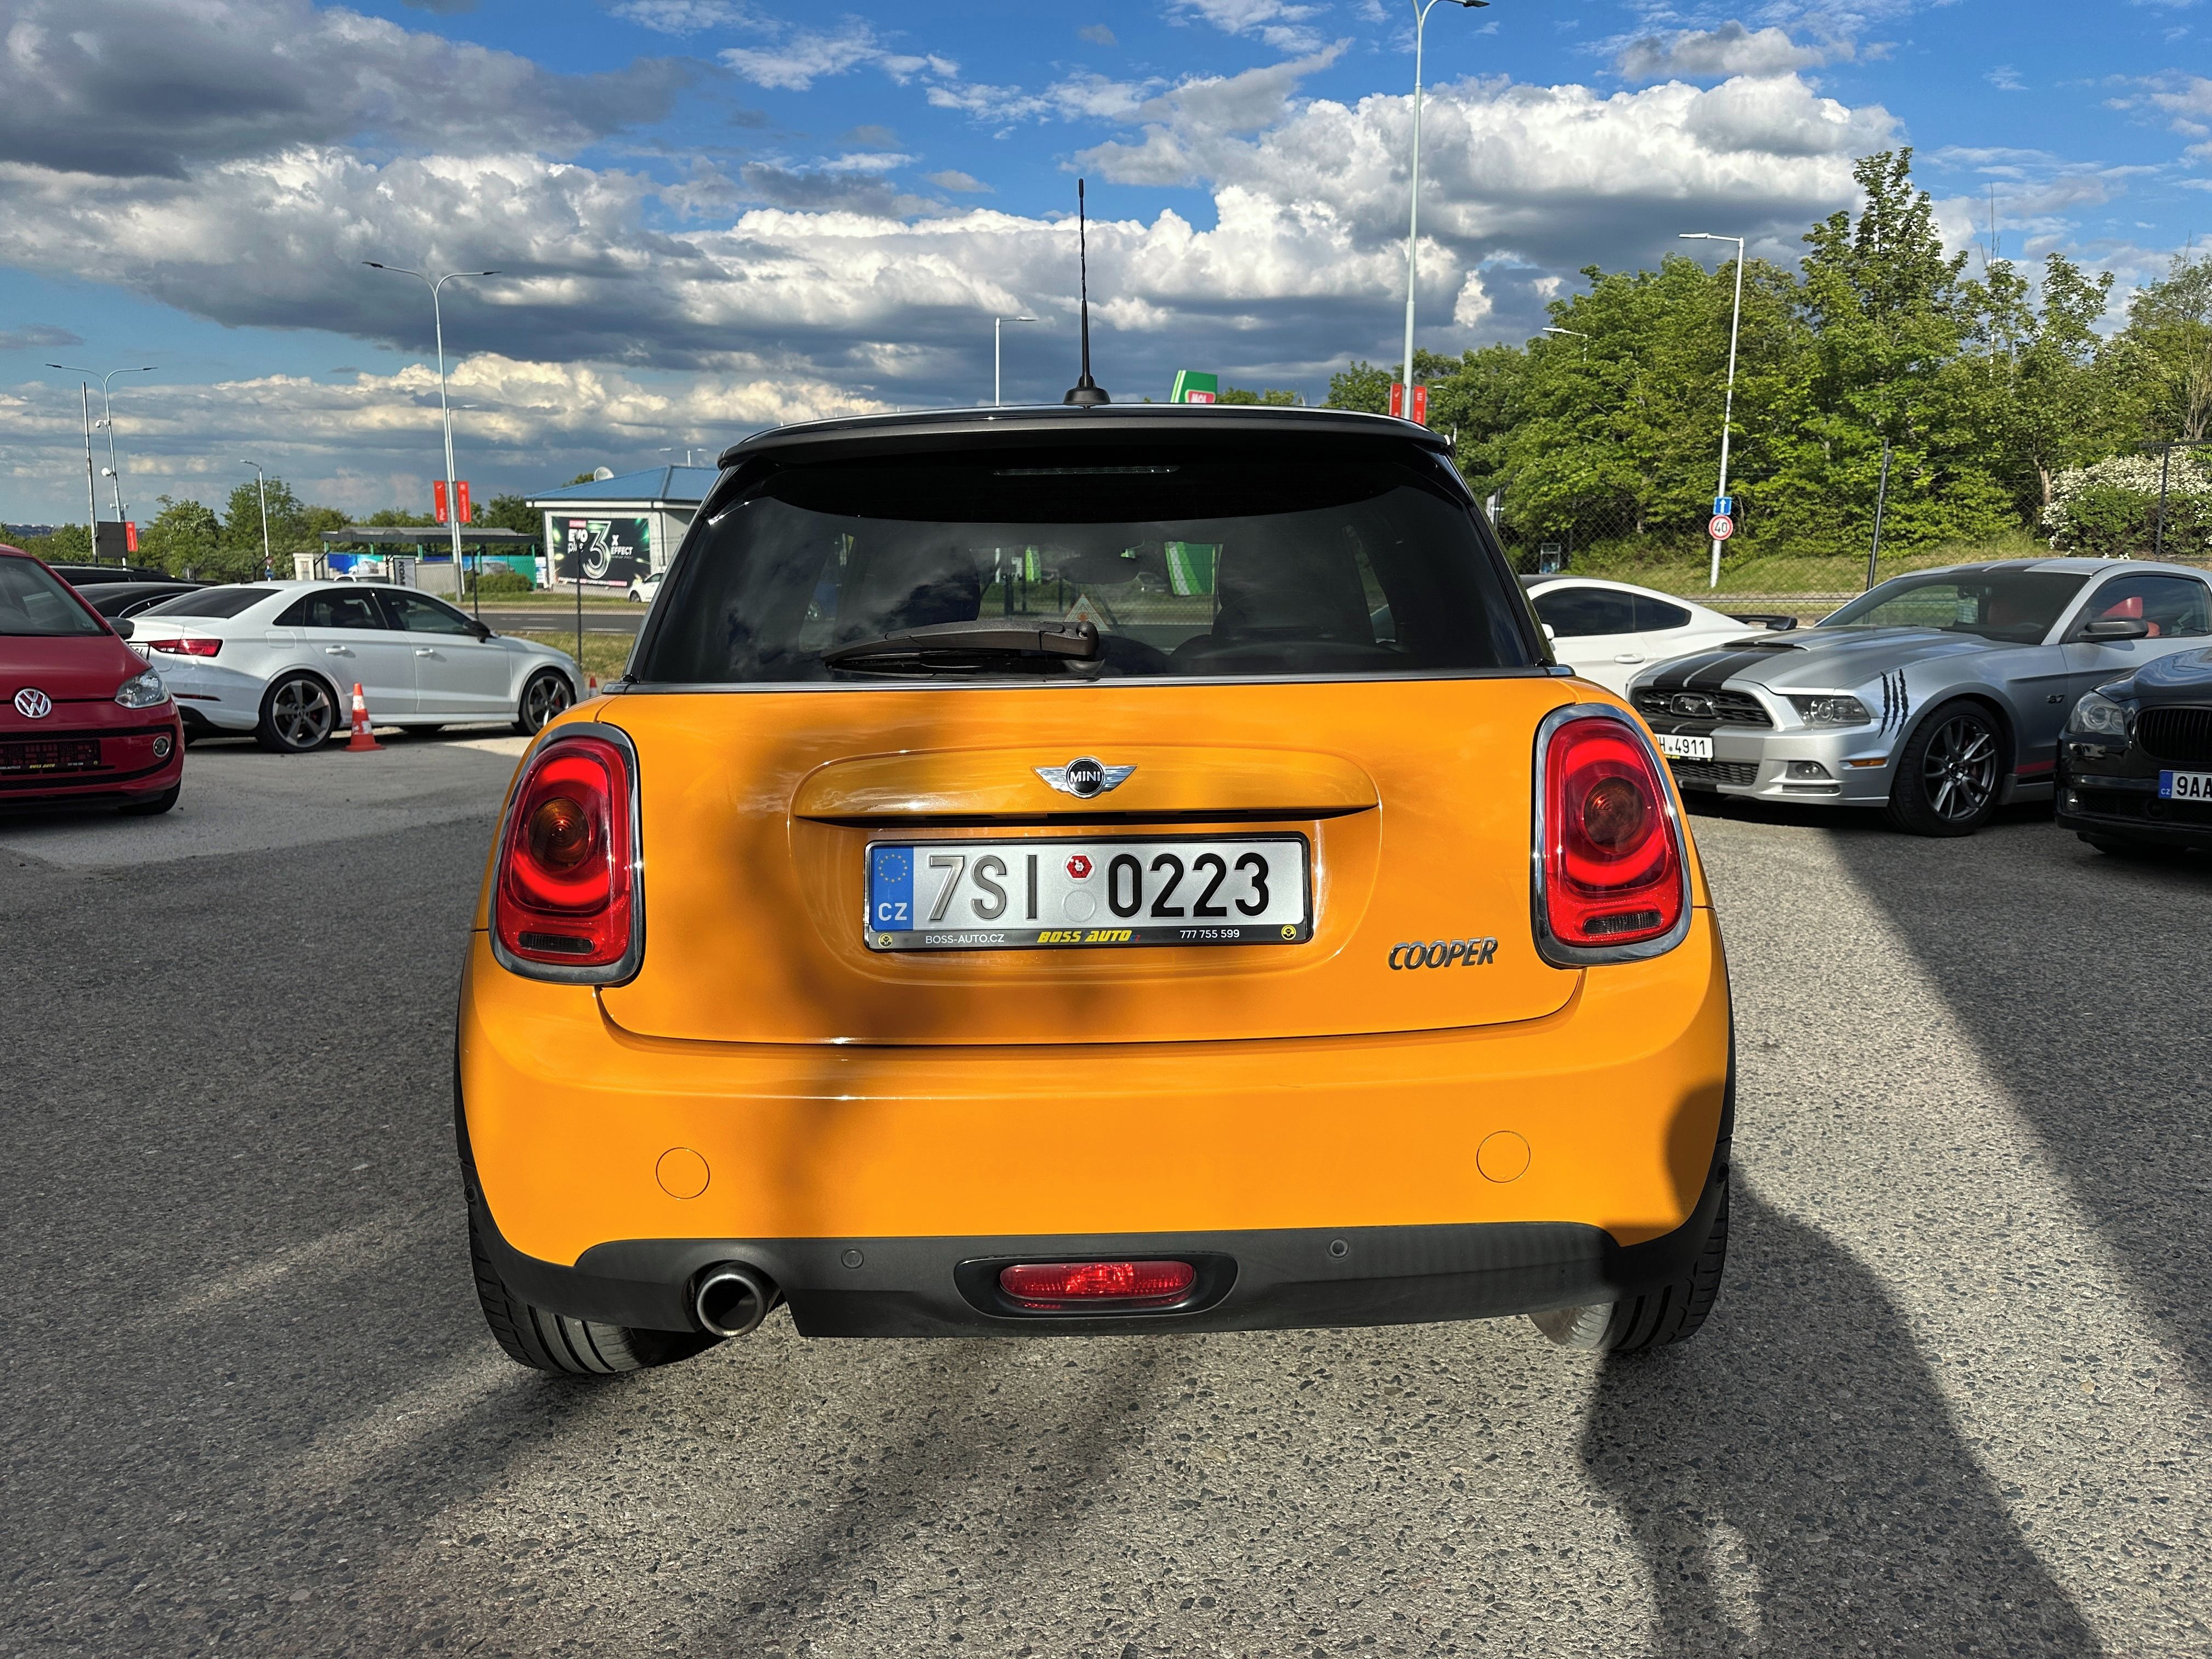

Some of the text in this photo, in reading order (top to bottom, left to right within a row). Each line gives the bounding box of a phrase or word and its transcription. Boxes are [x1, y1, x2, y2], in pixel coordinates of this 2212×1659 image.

[1715, 521, 1728, 533] 40
[568, 529, 588, 543] EVO
[582, 520, 611, 579] 3
[611, 546, 633, 555] EFFECT
[1675, 738, 1705, 755] 4911
[1070, 771, 1101, 782] MINI
[2176, 776, 2212, 798] 9AA
[878, 852, 1270, 922] CZ 7SI 0223
[925, 933, 1005, 944] BOSS-AUTO.CZ
[1037, 931, 1081, 943] BOSS
[1085, 930, 1133, 942] AUTO
[1180, 929, 1240, 939] 777 755 599
[1389, 936, 1498, 970] COOPER
